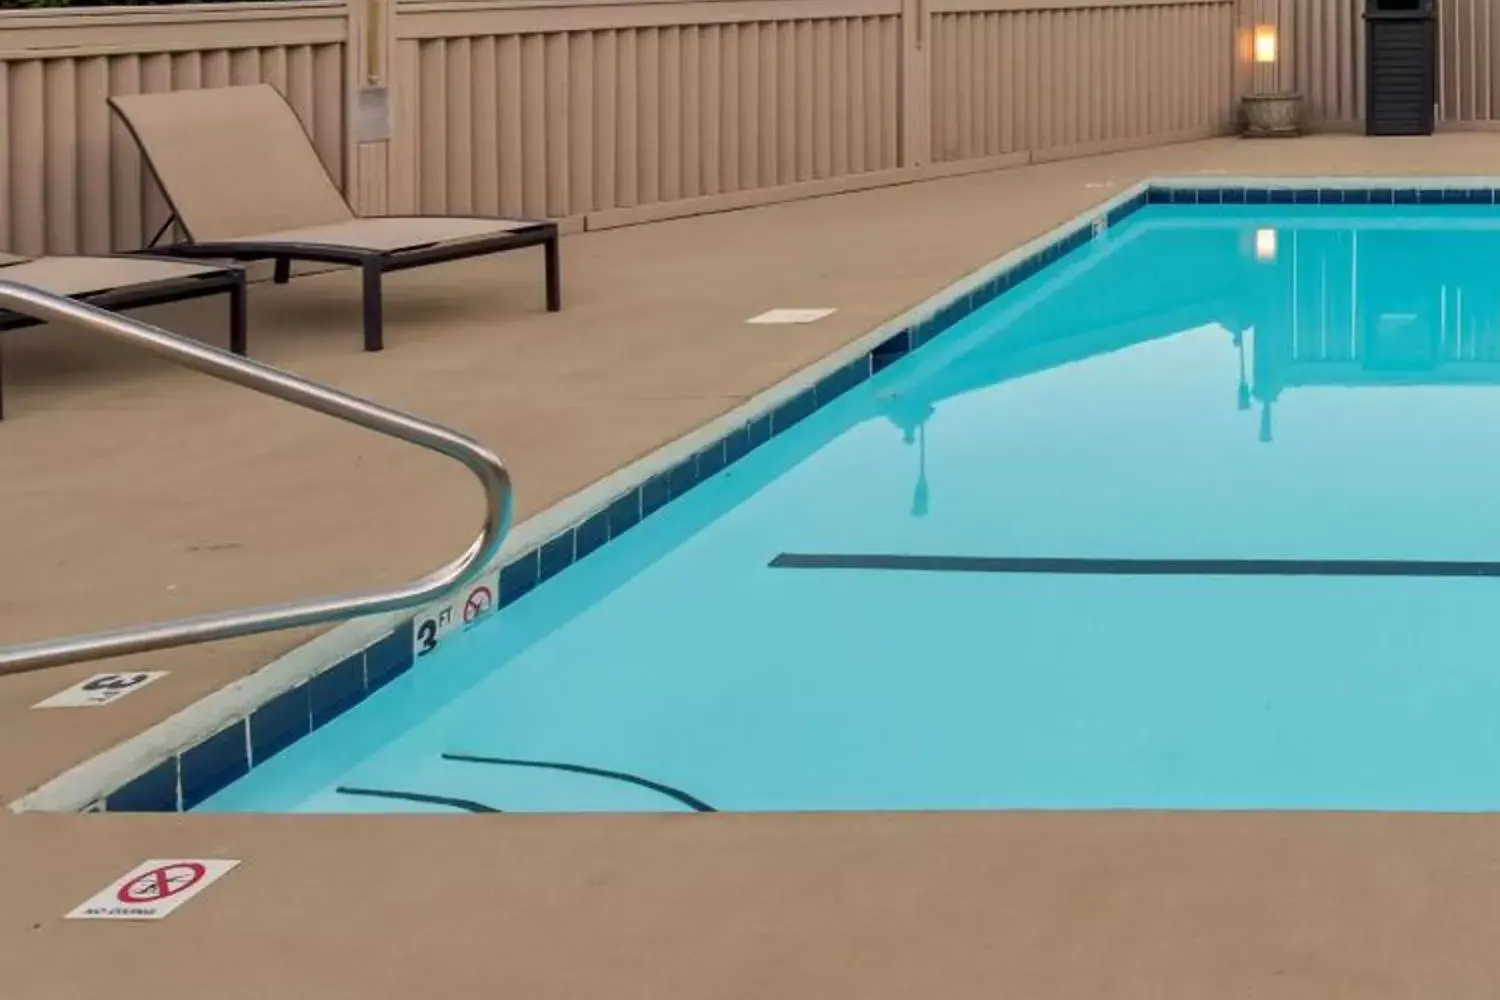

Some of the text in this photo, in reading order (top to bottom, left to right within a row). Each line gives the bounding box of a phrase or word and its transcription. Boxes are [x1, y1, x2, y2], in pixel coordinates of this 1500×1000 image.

[417, 605, 453, 657] 3 FT
[81, 673, 149, 690] 3
